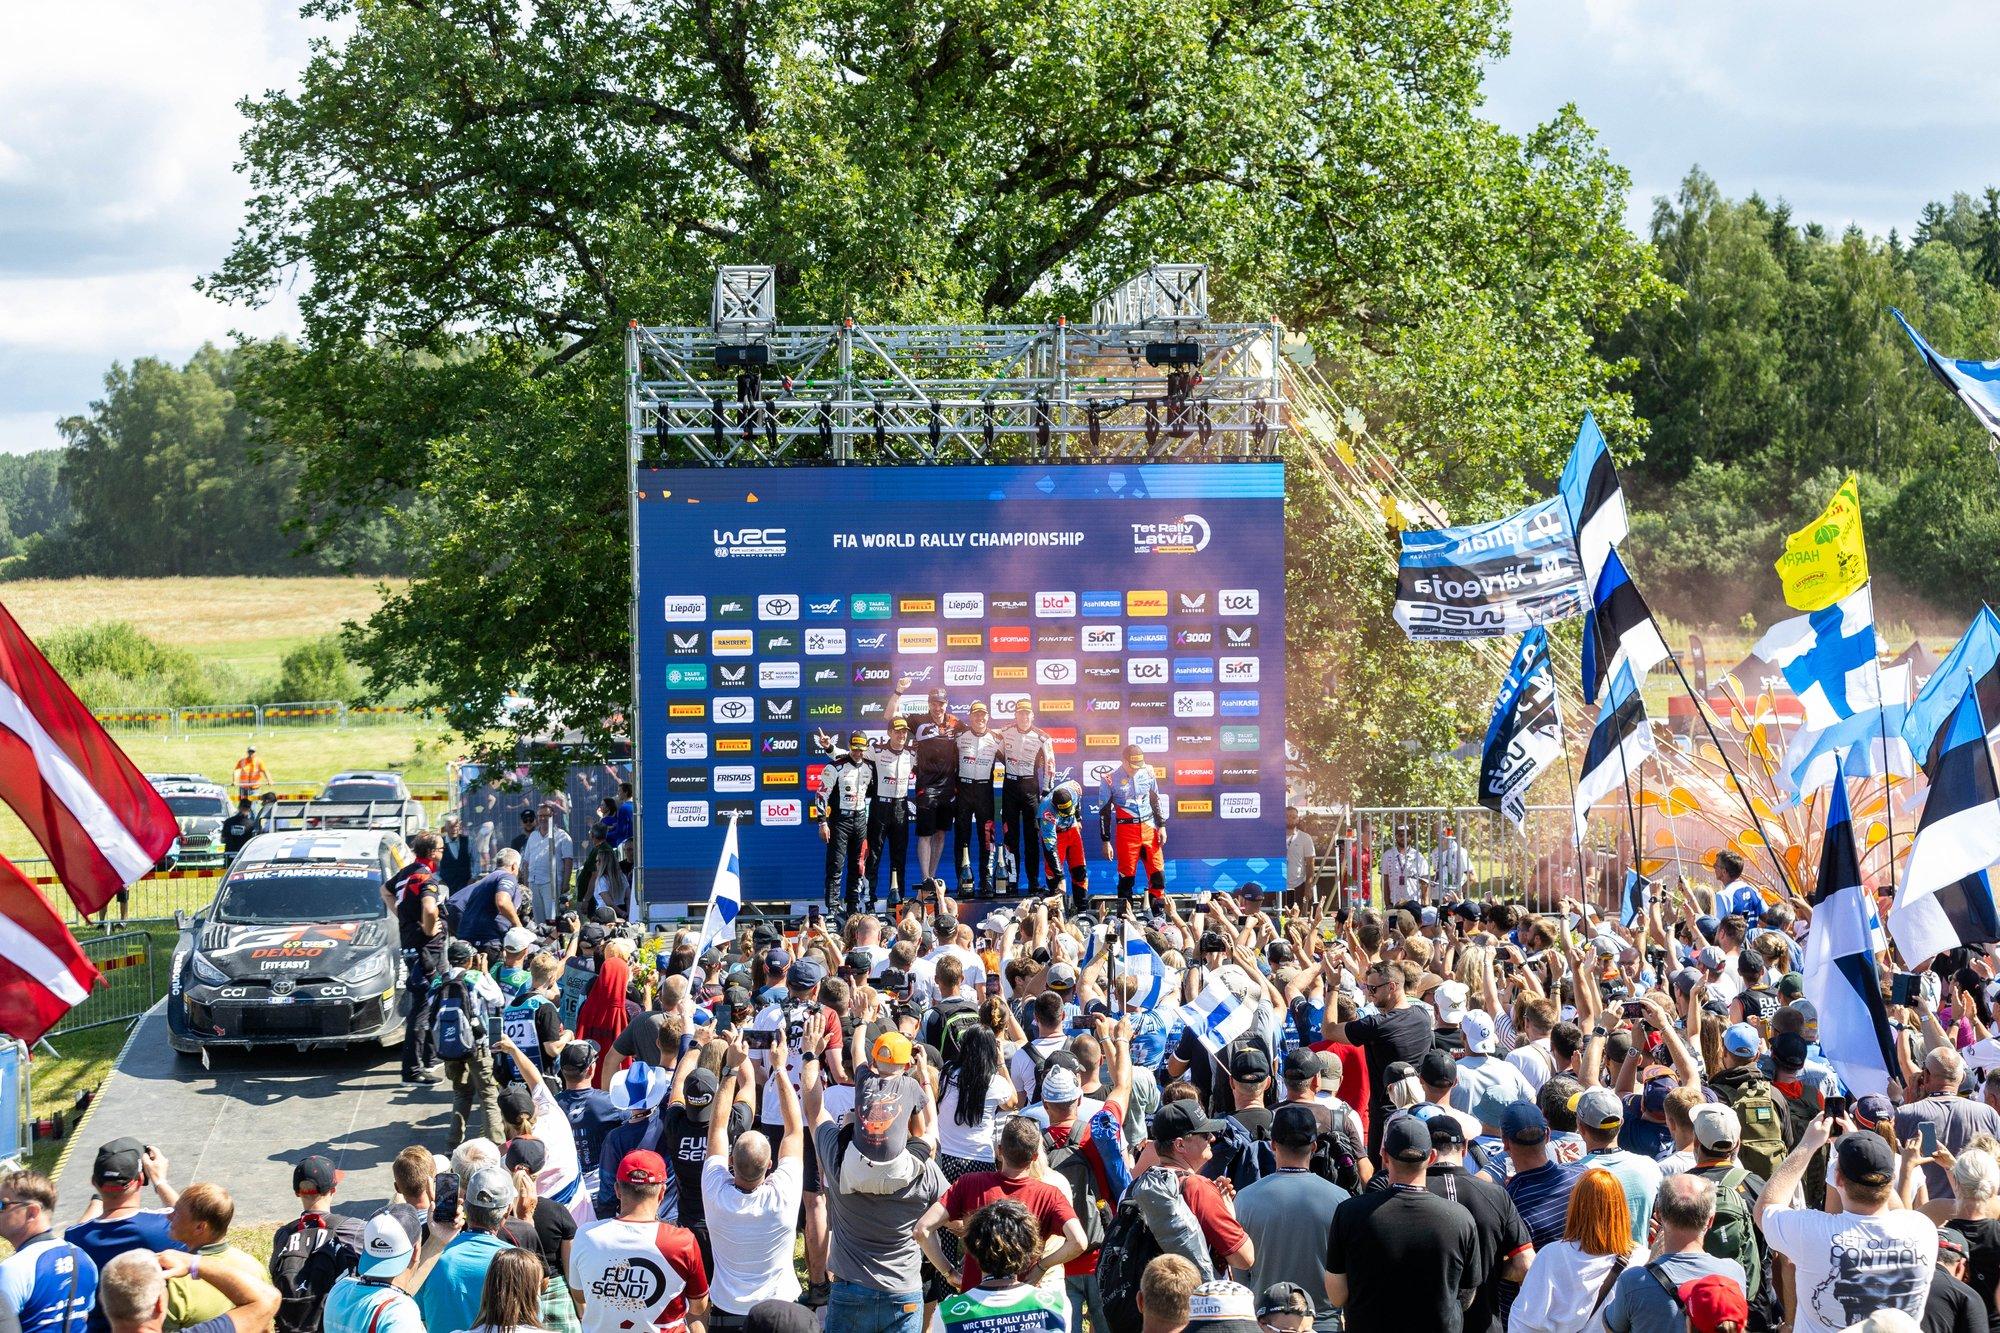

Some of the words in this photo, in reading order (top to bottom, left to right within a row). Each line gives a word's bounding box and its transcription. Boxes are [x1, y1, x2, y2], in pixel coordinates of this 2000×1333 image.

[1131, 524, 1156, 532] Tet
[1158, 523, 1194, 533] Rally
[714, 528, 787, 544] WRC
[833, 534, 858, 548] FIA
[862, 533, 915, 548] WORLD
[920, 532, 966, 546] RALLY
[969, 532, 1085, 546] CHAMPIONSHIP
[1134, 533, 1194, 544] Latvia
[903, 602, 932, 610] PIRELLI
[1042, 597, 1064, 608] bta
[1224, 595, 1253, 610] tet
[950, 636, 978, 644] PIRELLI
[996, 669, 1024, 677] PIRELLI
[1134, 664, 1162, 678] tet
[954, 673, 982, 681] Latvia
[1042, 702, 1071, 710] PIRELLI
[1088, 736, 1117, 744] PIRELLI
[1136, 736, 1161, 744] Delfi
[1180, 802, 1209, 810] PIRELLI
[1222, 798, 1253, 806] MISSION
[670, 806, 702, 814] MISSION
[768, 805, 789, 816] bta
[1230, 806, 1258, 814] Latvia
[678, 814, 706, 822] Latvia
[244, 869, 368, 880] WRC-FANSHOP.COM
[282, 940, 301, 948] 69
[251, 948, 324, 958] DENSO
[221, 988, 247, 997] CCI
[320, 986, 347, 996] CCI
[566, 998, 577, 1012] 16
[1760, 1007, 1781, 1019] SEN
[503, 1024, 525, 1038] 02
[1868, 1239, 1899, 1250] OUT
[602, 1266, 649, 1284] FULL
[592, 1281, 648, 1299] SEND!
[962, 1322, 979, 1331] WRC
[980, 1319, 995, 1327] TET
[996, 1316, 1021, 1325] RALLY
[1022, 1311, 1050, 1321] LATVIA
[1004, 1325, 1018, 1333] JUL
